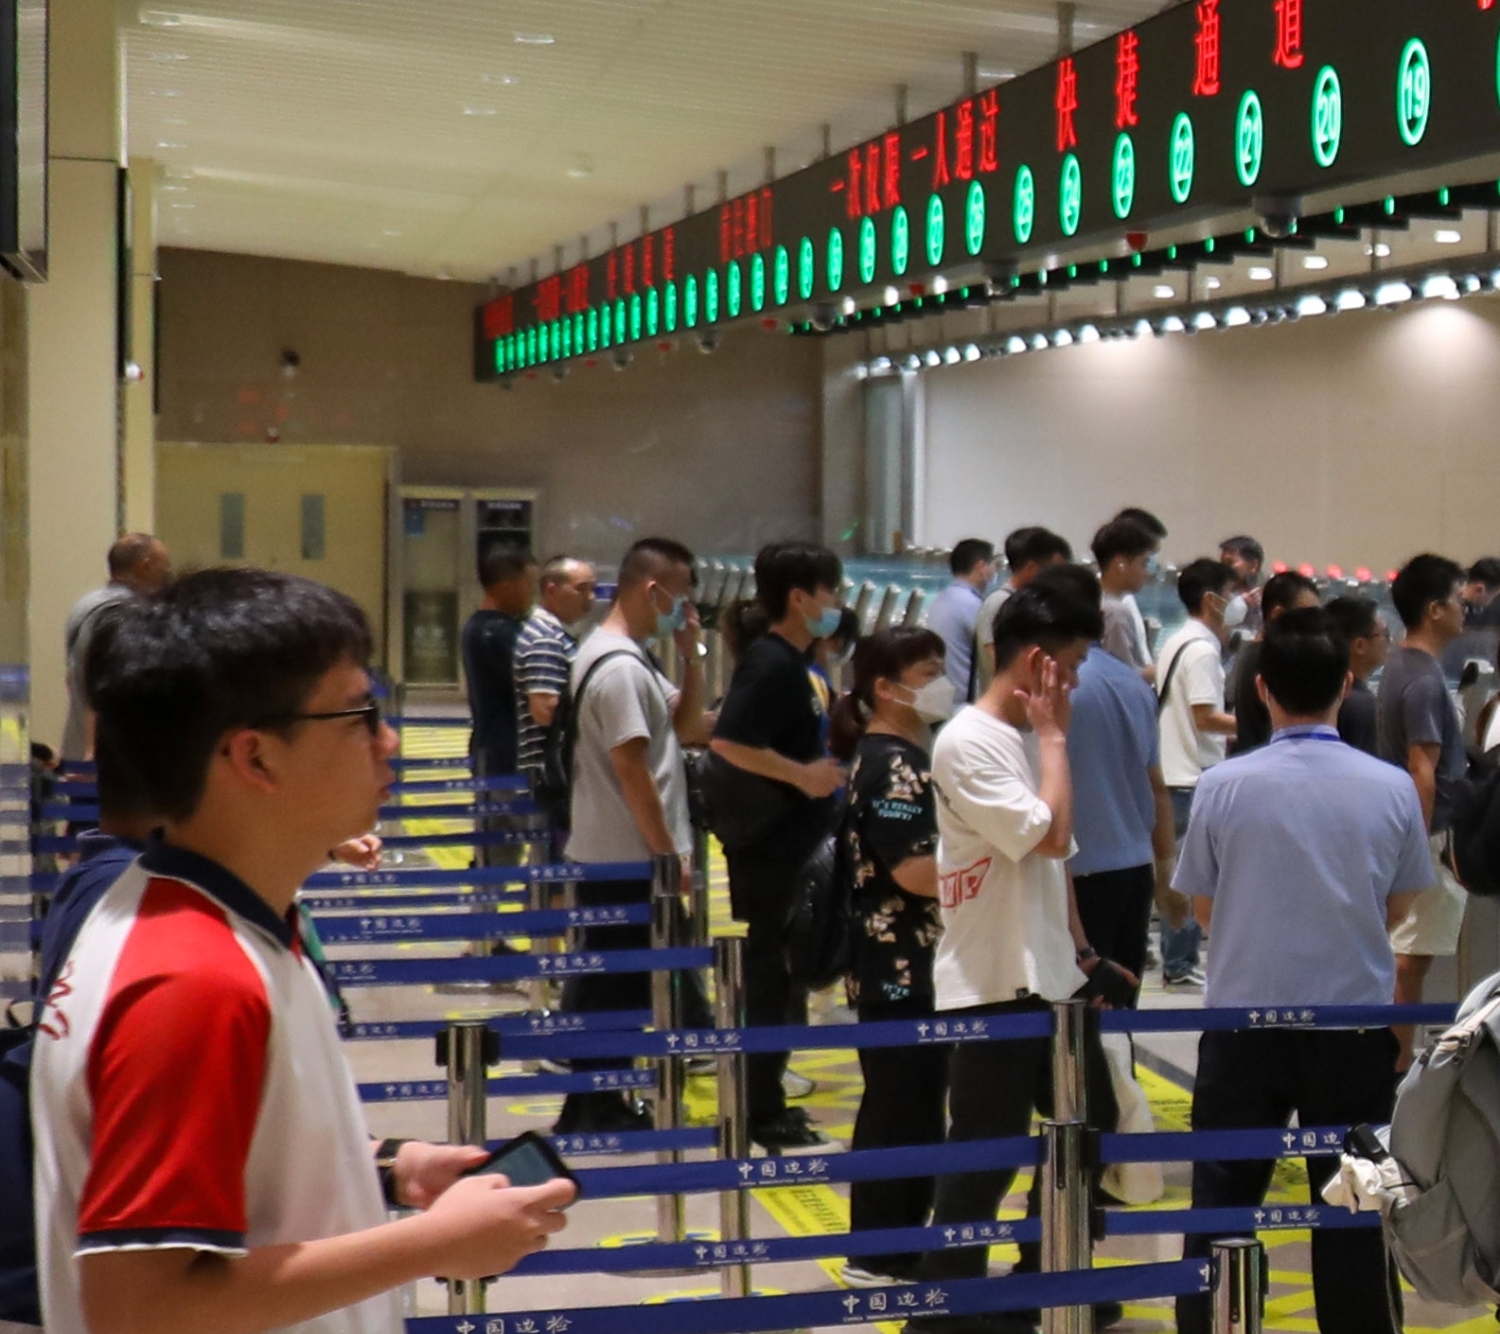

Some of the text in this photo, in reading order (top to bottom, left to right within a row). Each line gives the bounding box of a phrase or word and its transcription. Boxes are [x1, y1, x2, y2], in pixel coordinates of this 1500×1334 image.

[1282, 1131, 1341, 1149] 中国边
[738, 1157, 829, 1179] 中国边检
[842, 1288, 949, 1314] 中国边检
